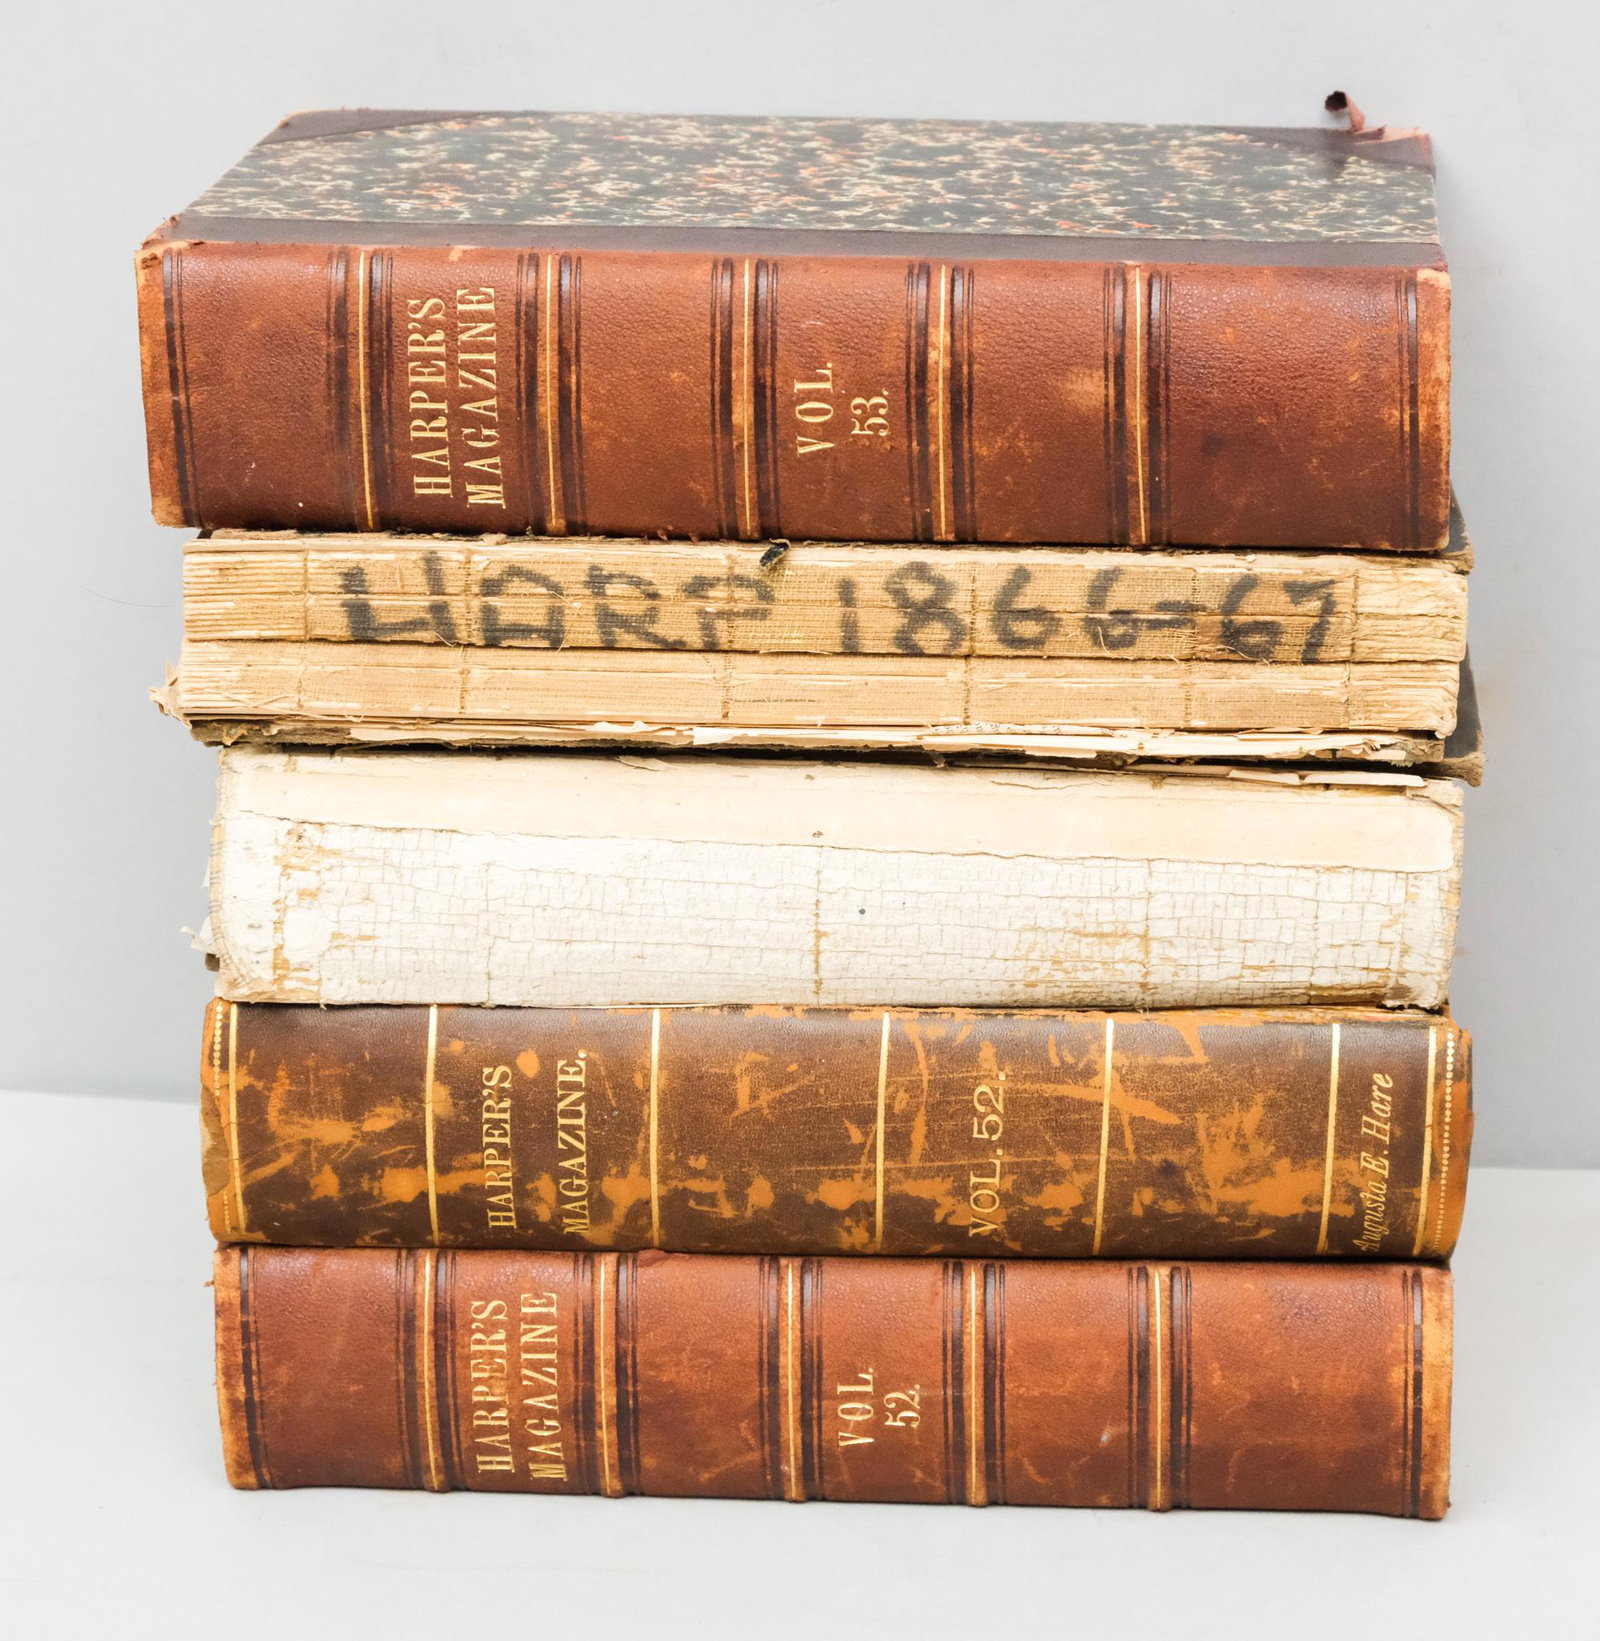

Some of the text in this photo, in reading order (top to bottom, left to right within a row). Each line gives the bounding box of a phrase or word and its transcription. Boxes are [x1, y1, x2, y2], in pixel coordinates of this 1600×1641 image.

[407, 297, 454, 498] HARPER'S
[456, 287, 506, 510] MAGAZINE
[793, 362, 835, 457] VOL.
[850, 387, 891, 437] 53.
[338, 550, 1336, 663] HARP 1866-67
[482, 1064, 517, 1230] HARPER'S
[556, 1049, 591, 1235] MAGAZINE.
[968, 1071, 1006, 1238] VOL. 52.
[1353, 1072, 1394, 1252] Augusta E. Hare
[470, 1299, 516, 1474] HARPER'S
[520, 1292, 568, 1482] MAGAZINE
[836, 1367, 875, 1449] VOL.
[883, 1384, 921, 1429] 52.
